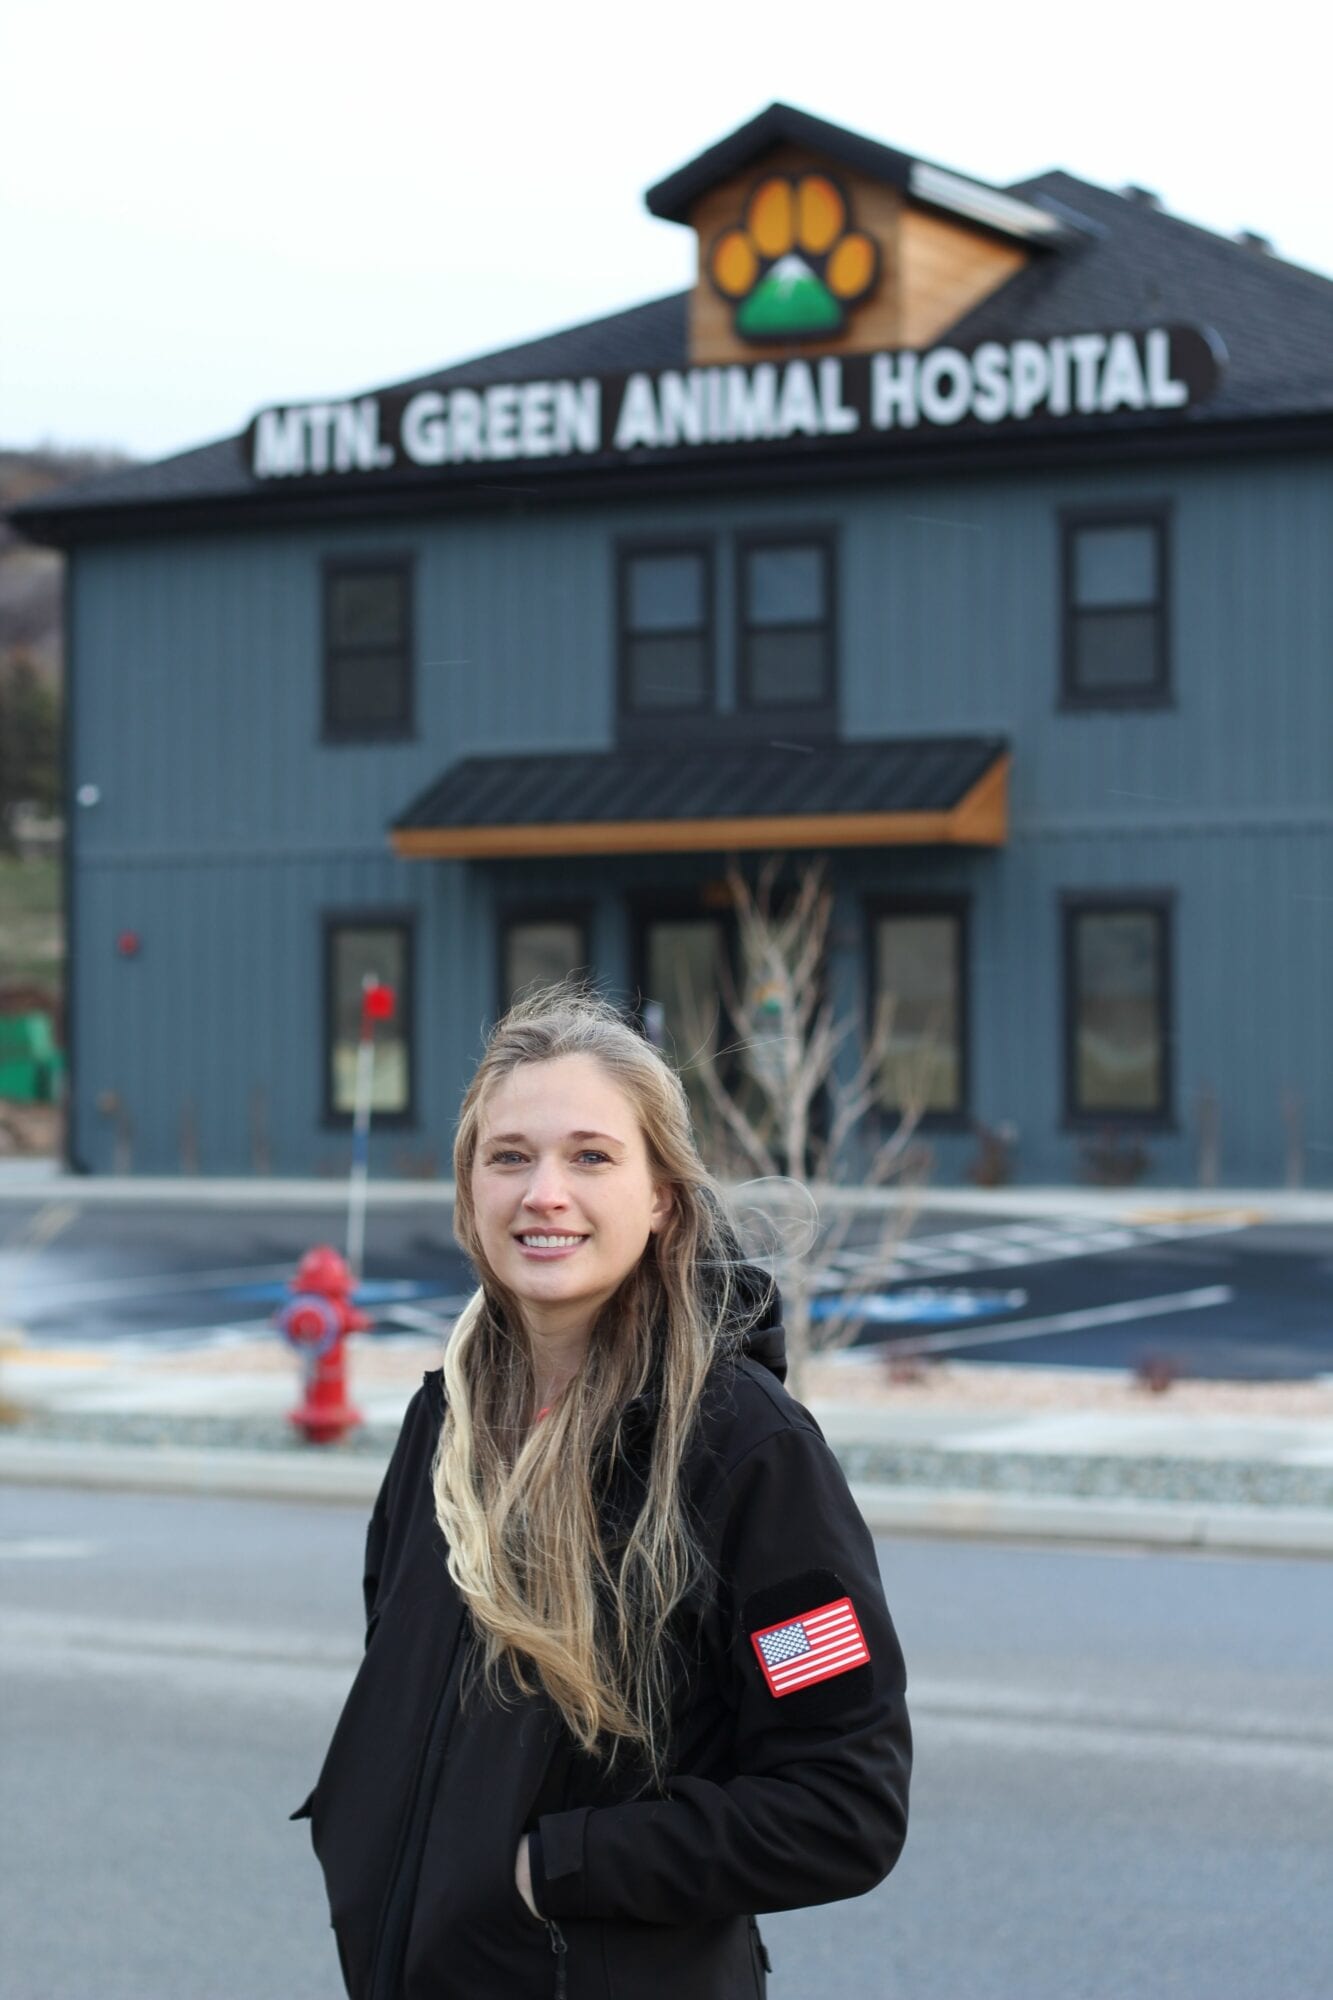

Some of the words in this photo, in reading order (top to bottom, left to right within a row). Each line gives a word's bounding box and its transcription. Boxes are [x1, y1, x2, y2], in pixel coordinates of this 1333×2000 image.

[253, 402, 394, 478] MTN.
[402, 378, 600, 465] GREEN
[614, 357, 857, 449] ANIMAL
[873, 328, 1188, 429] HOSPITAL
